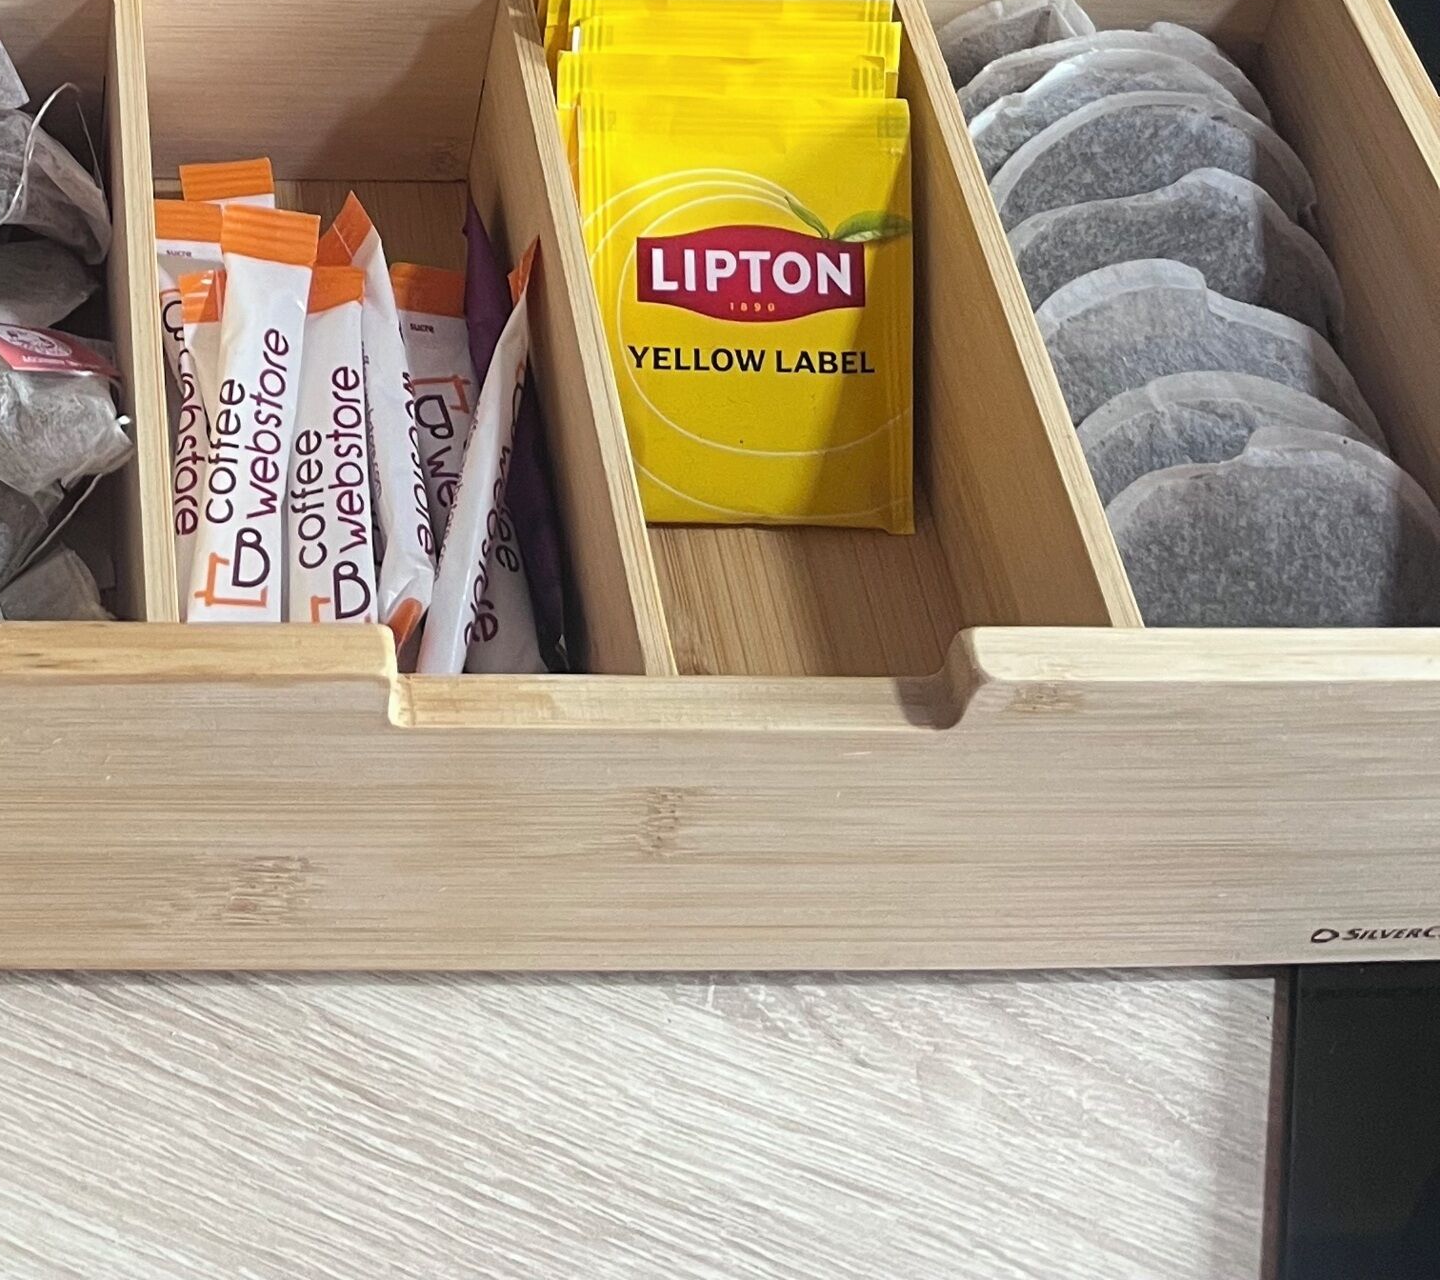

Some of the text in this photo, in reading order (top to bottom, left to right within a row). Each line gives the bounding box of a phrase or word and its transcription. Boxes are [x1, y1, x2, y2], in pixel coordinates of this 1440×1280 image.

[651, 247, 852, 297] LIPTON
[729, 301, 776, 313] 1890
[245, 327, 291, 521] webstore
[627, 345, 876, 375] YELLOW LABEL
[204, 378, 246, 524] coffee
[290, 429, 328, 570] coffee
[328, 365, 366, 545] webstore
